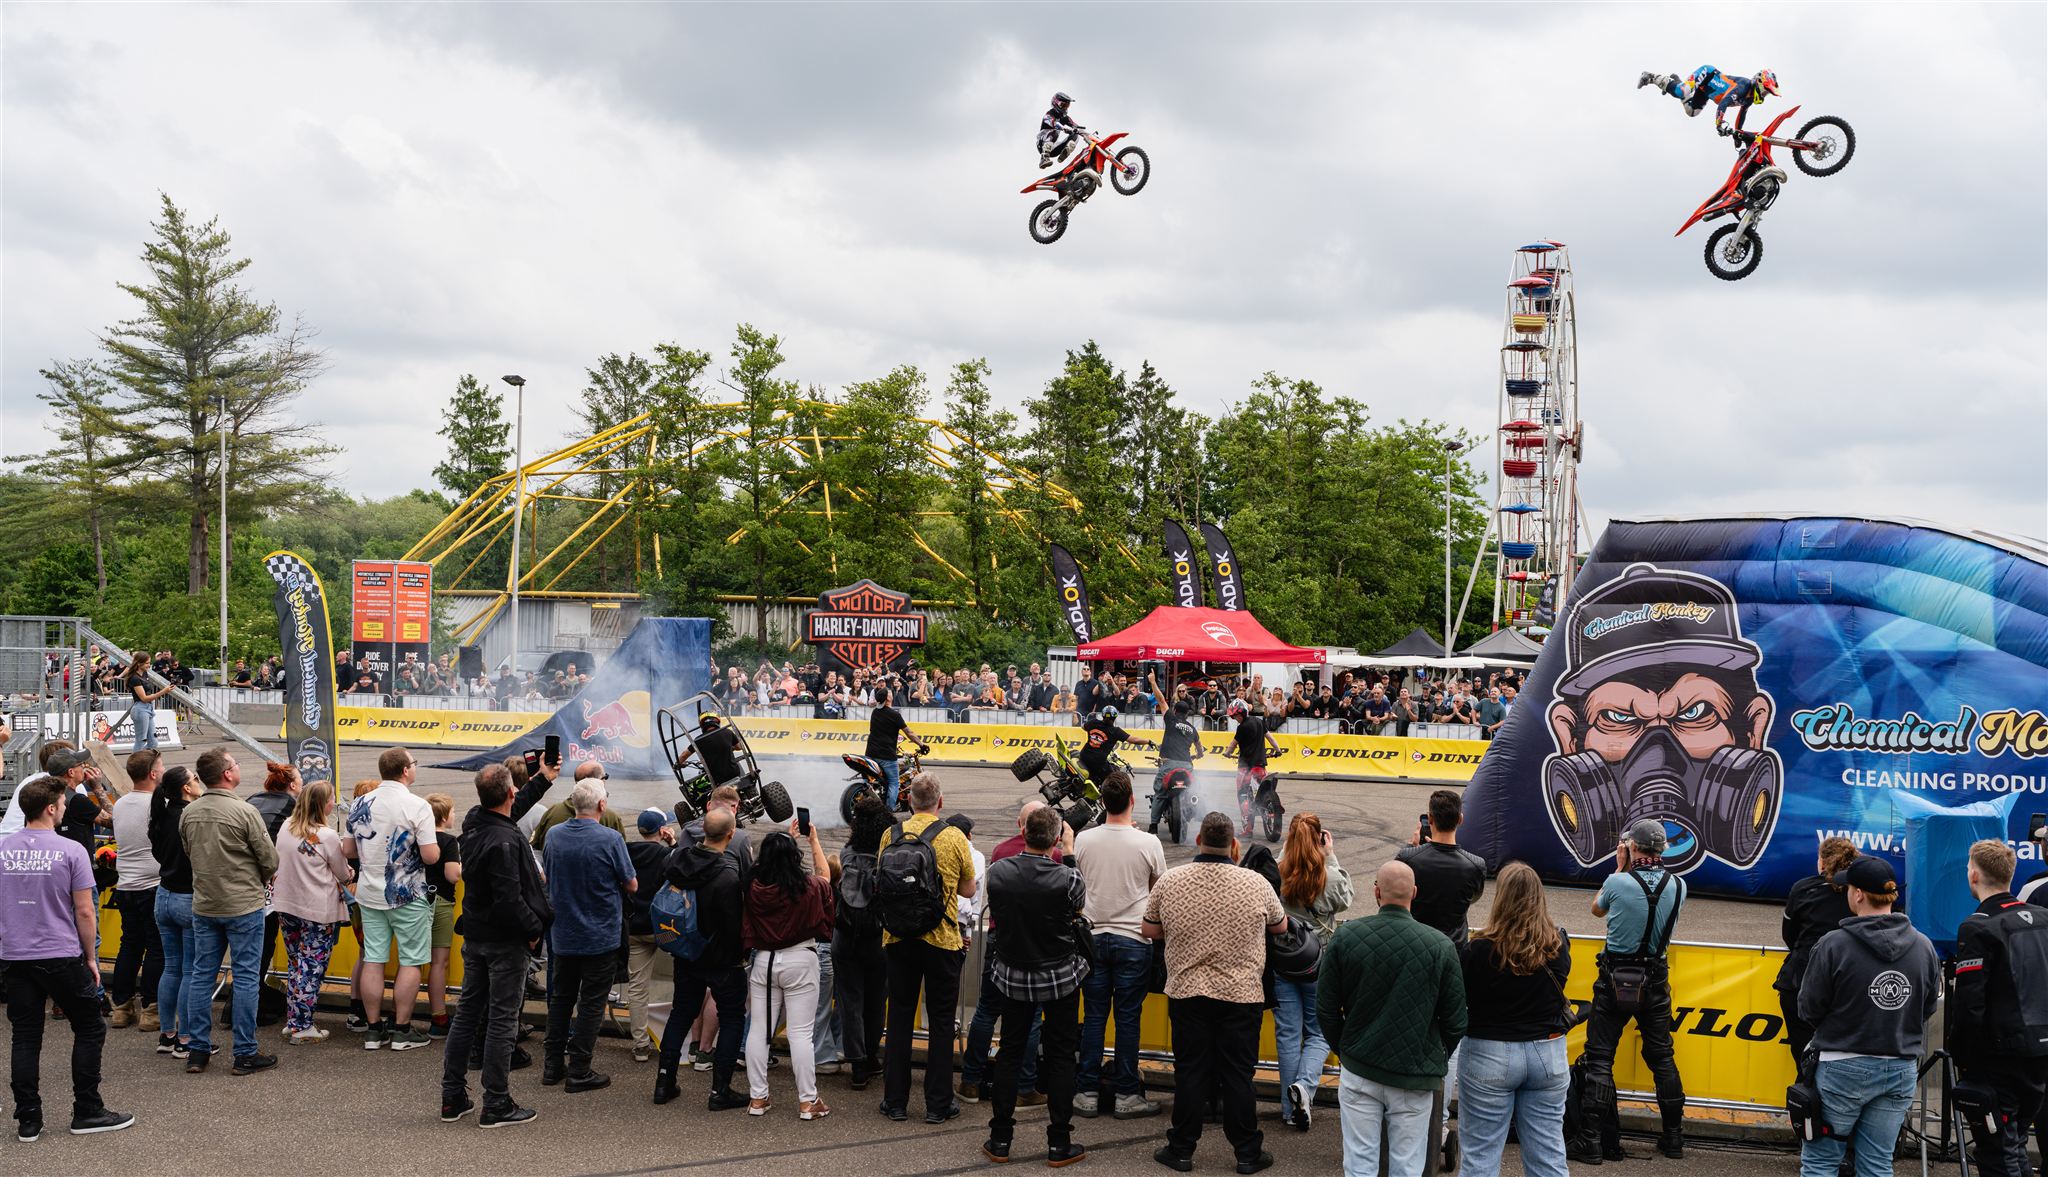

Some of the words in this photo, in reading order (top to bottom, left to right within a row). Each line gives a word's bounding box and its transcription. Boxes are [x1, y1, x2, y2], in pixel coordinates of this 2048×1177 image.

[840, 590, 895, 612] MOTOR
[1584, 604, 1651, 640] Chemical
[1650, 601, 1715, 624] Monkey
[814, 617, 919, 639] HARLEY-DAVIDSON
[365, 651, 381, 661] RIDE
[838, 642, 895, 667] CYCLES
[1080, 648, 1100, 656] DUCATI
[1156, 648, 1185, 656] DUCATI
[378, 719, 440, 730] DUNLOP
[460, 723, 524, 733] DUNLOP
[1792, 703, 1978, 754] Chemical
[813, 732, 870, 742] DUNLO
[1316, 748, 1399, 760] DUNLOP
[1427, 753, 1482, 764] DUNL
[1842, 769, 1956, 790] CLEANING
[30, 850, 64, 861] BLUE
